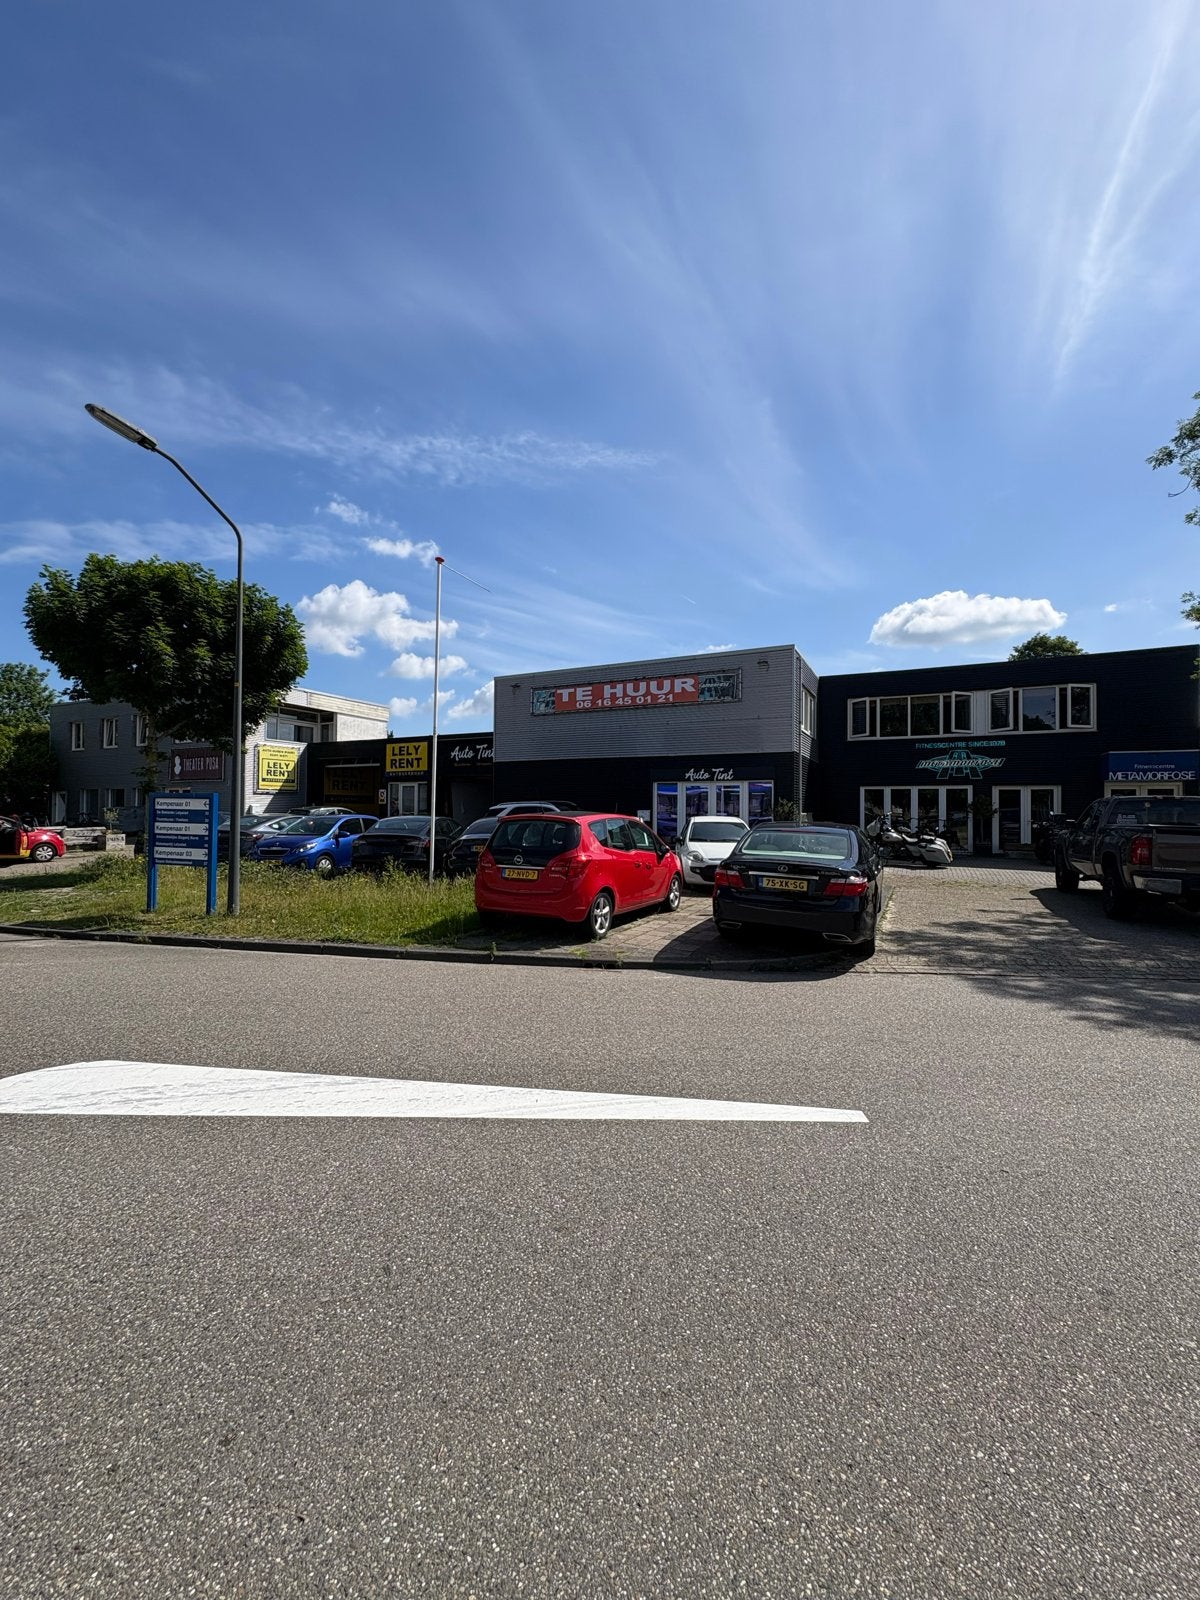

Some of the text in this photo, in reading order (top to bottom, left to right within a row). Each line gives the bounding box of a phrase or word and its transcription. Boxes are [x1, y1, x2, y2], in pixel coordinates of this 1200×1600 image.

[556, 687, 593, 702] TE
[603, 678, 696, 698] HUUR
[576, 693, 674, 709] 06 16 45 01 21
[392, 745, 421, 756] LELY
[915, 741, 967, 749] FITNESSCENTRE
[968, 740, 989, 748] SINCE
[450, 745, 475, 761] Auto
[183, 756, 219, 771] THEATER POSA
[267, 761, 290, 769] LELY
[390, 757, 423, 769] RENT
[266, 769, 291, 777] RENT
[685, 767, 734, 781] Auto Tint
[1108, 770, 1196, 781] METAMORFOSE
[506, 869, 536, 878] 27-NVD-7
[765, 877, 805, 889] 75-XK-SG
